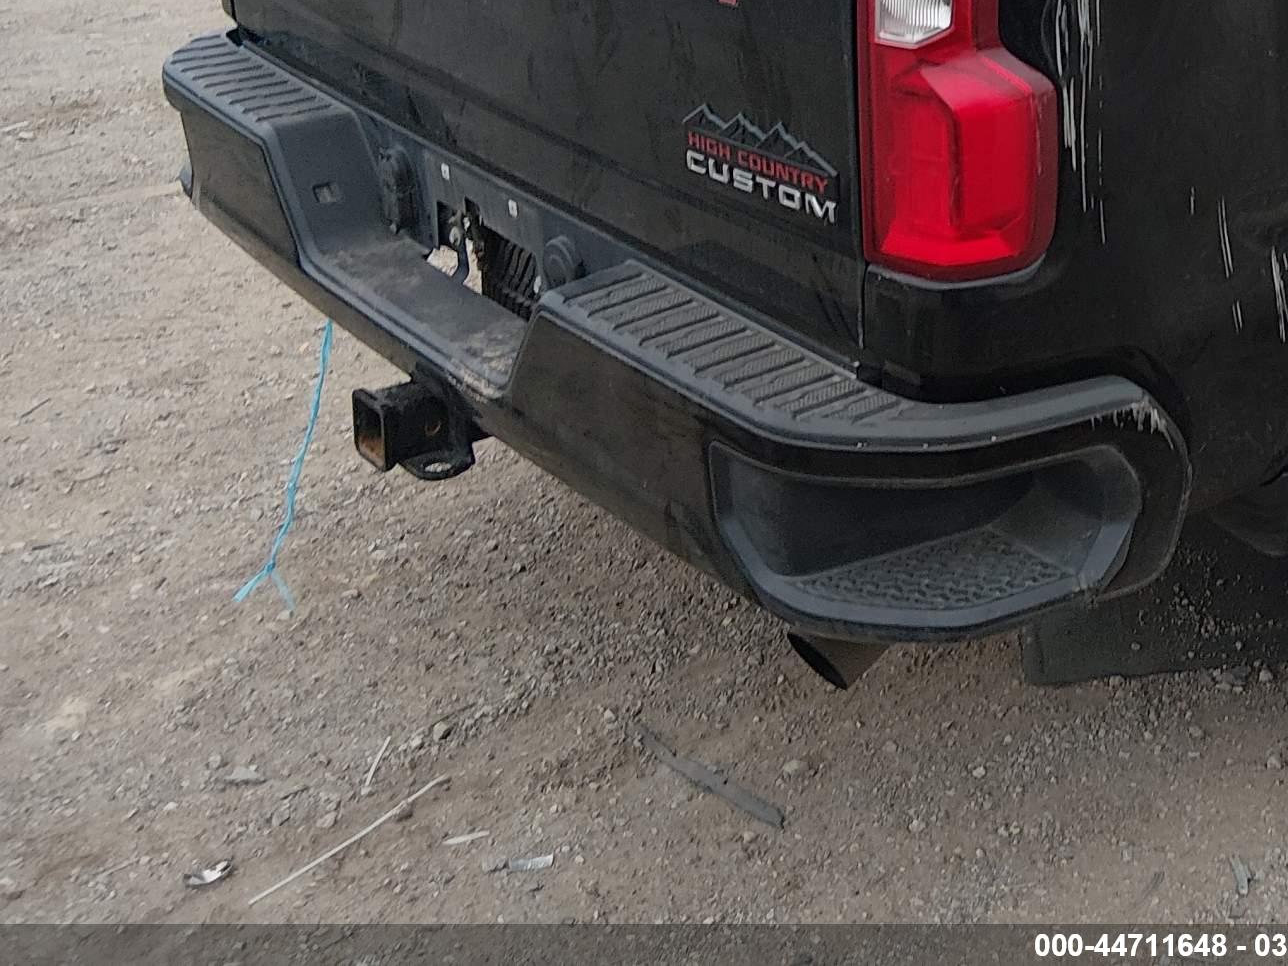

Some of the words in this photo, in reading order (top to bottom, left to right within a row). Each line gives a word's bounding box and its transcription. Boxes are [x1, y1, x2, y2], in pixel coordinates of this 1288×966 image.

[686, 148, 838, 225] CUSTOM
[687, 130, 731, 162] HIGH
[737, 149, 829, 195] COUNTRY
